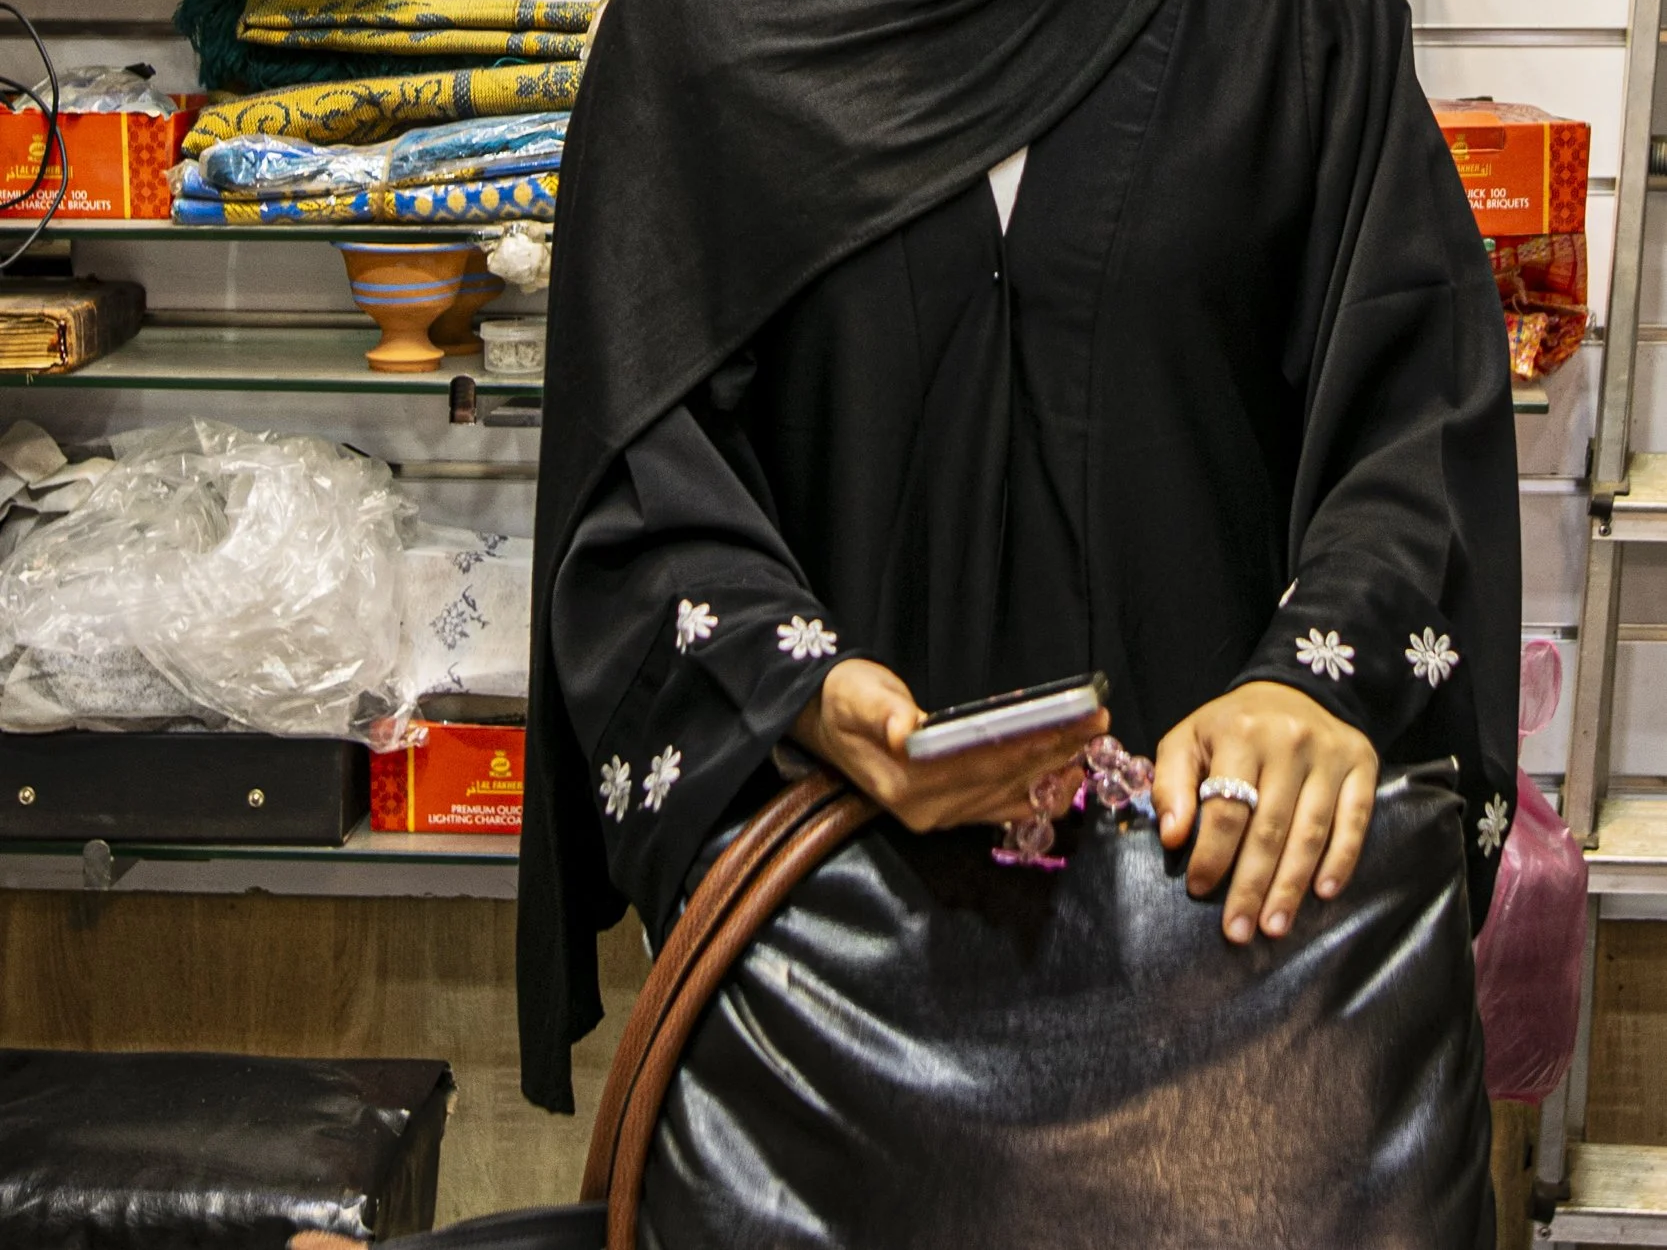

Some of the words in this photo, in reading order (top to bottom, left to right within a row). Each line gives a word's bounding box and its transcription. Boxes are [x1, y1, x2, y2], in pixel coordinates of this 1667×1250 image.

[71, 190, 87, 199] 100
[1466, 188, 1486, 198] UICK
[1490, 187, 1506, 198] 100
[68, 200, 111, 210] BRIQUETS
[1486, 198, 1529, 209] BRIQUETS
[451, 804, 496, 814] PREMIUM
[496, 805, 522, 815] QUIC
[428, 814, 473, 824] LIGHTING
[474, 815, 522, 825] CHARCOA
